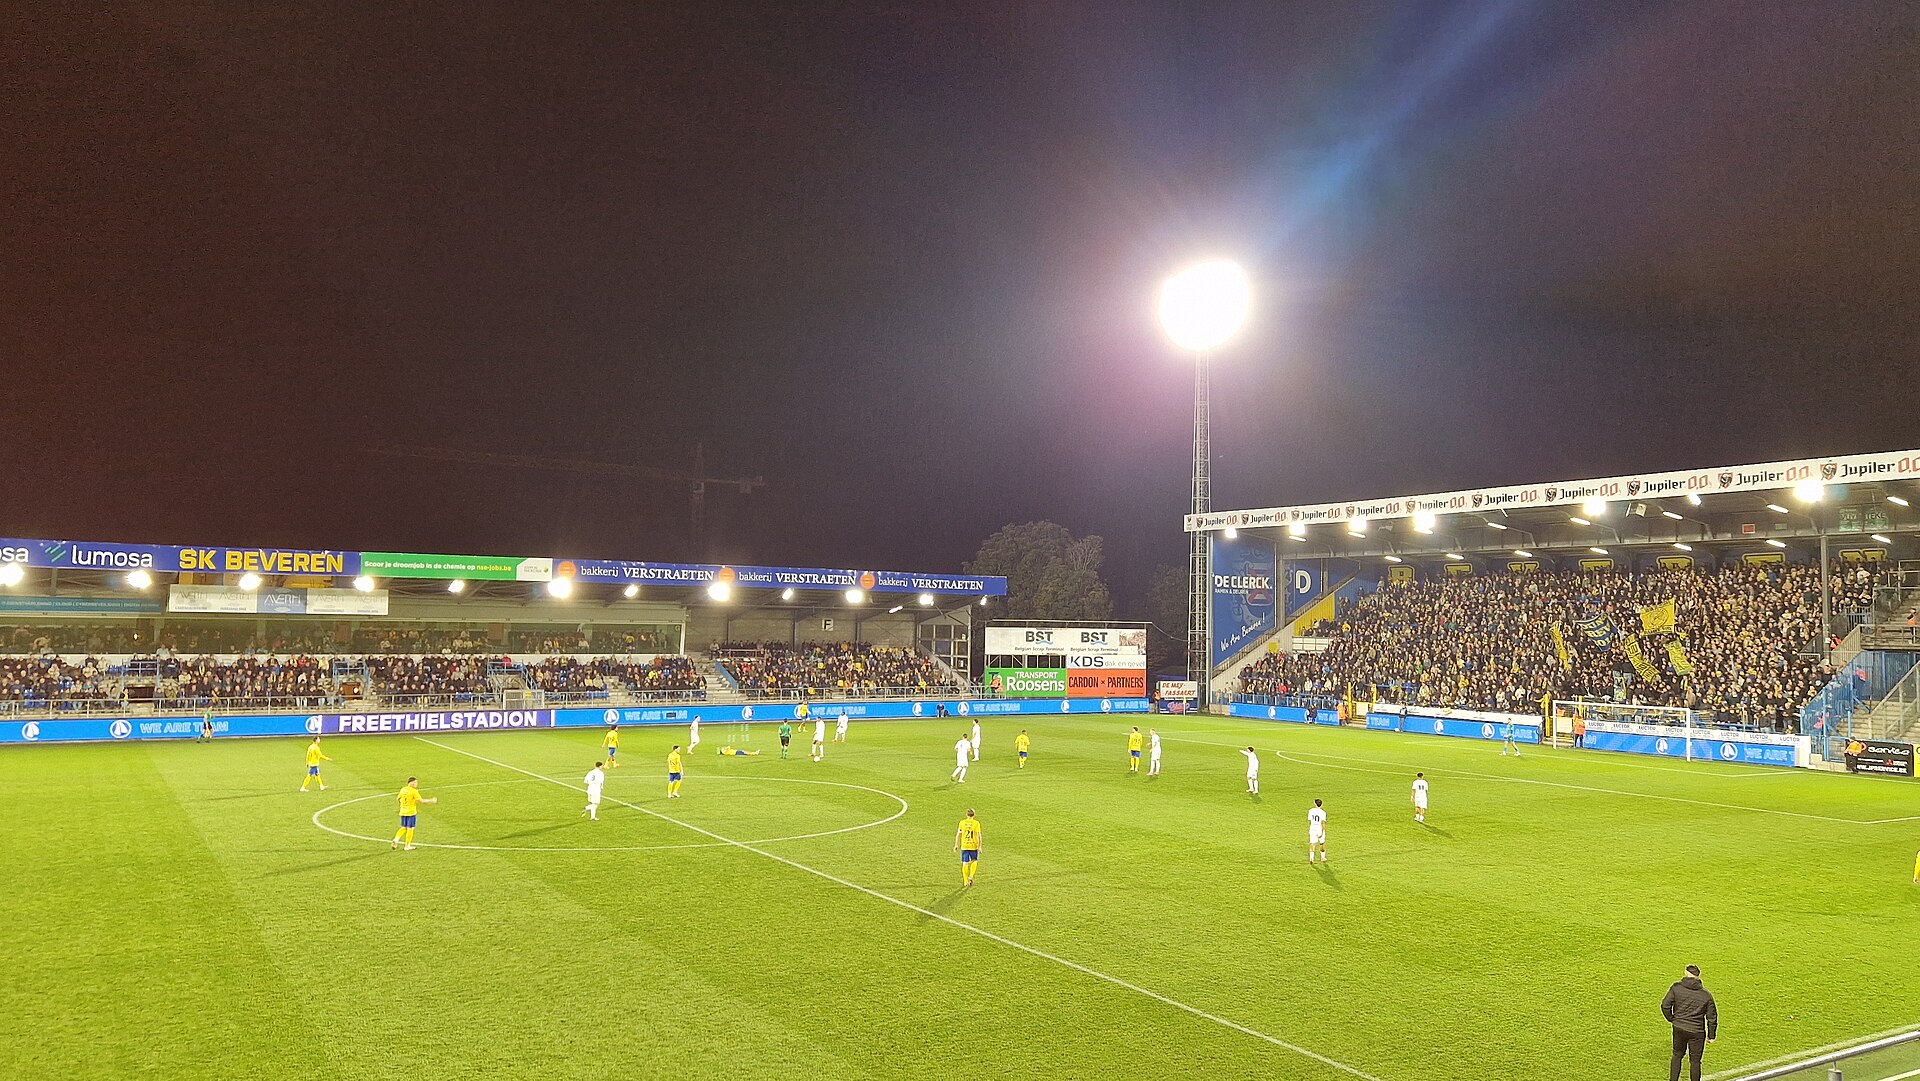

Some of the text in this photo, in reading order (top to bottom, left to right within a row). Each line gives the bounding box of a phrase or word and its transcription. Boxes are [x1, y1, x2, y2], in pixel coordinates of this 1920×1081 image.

[1839, 461, 1896, 478] Jupiler
[1736, 471, 1784, 486] Jupiler
[1642, 479, 1686, 494] Jupiler
[1484, 493, 1519, 506] Jupiler
[1559, 487, 1598, 500] Jupiler
[1356, 505, 1385, 517] Jupiler
[1417, 500, 1448, 511] Jupiler
[1250, 514, 1274, 524] Jupiler
[1301, 510, 1327, 520] Jupiler
[1204, 517, 1226, 527] Jupiler
[0, 547, 29, 563] sa
[71, 544, 153, 568] lumosa
[179, 549, 343, 573] SK BEVEREN
[364, 560, 385, 568] Scoor
[385, 561, 392, 569] je
[392, 561, 425, 569] droomjob
[466, 564, 476, 572] op
[476, 564, 512, 572] nse-jobs.be
[580, 565, 715, 581] bakkerij VERSTRAETEN
[738, 570, 857, 586] bakkerij VERSTRAETEN
[878, 576, 984, 591] bakkerij VERSTRAETEN
[1214, 575, 1230, 588] DE
[1295, 570, 1312, 594] D
[824, 619, 832, 630] F
[1025, 631, 1053, 643] BST
[1081, 632, 1108, 643] BST
[1070, 656, 1104, 667] KDS
[1015, 671, 1058, 679] TRANSPORT
[1006, 676, 1065, 693] Roosens
[1068, 676, 1099, 688] CARDON
[1107, 676, 1144, 688] PARTNERS
[812, 706, 867, 715] WE ARE TEAM
[973, 703, 1020, 712] WE ARE TEAM
[338, 710, 537, 733] FREETHIELSTADION
[624, 711, 639, 720] WE
[641, 710, 662, 719] ARE
[139, 722, 161, 735] WE
[163, 721, 191, 734] ARE
[1744, 747, 1762, 759] WE
[1764, 749, 1787, 760] ARE
[966, 829, 974, 839] 21
